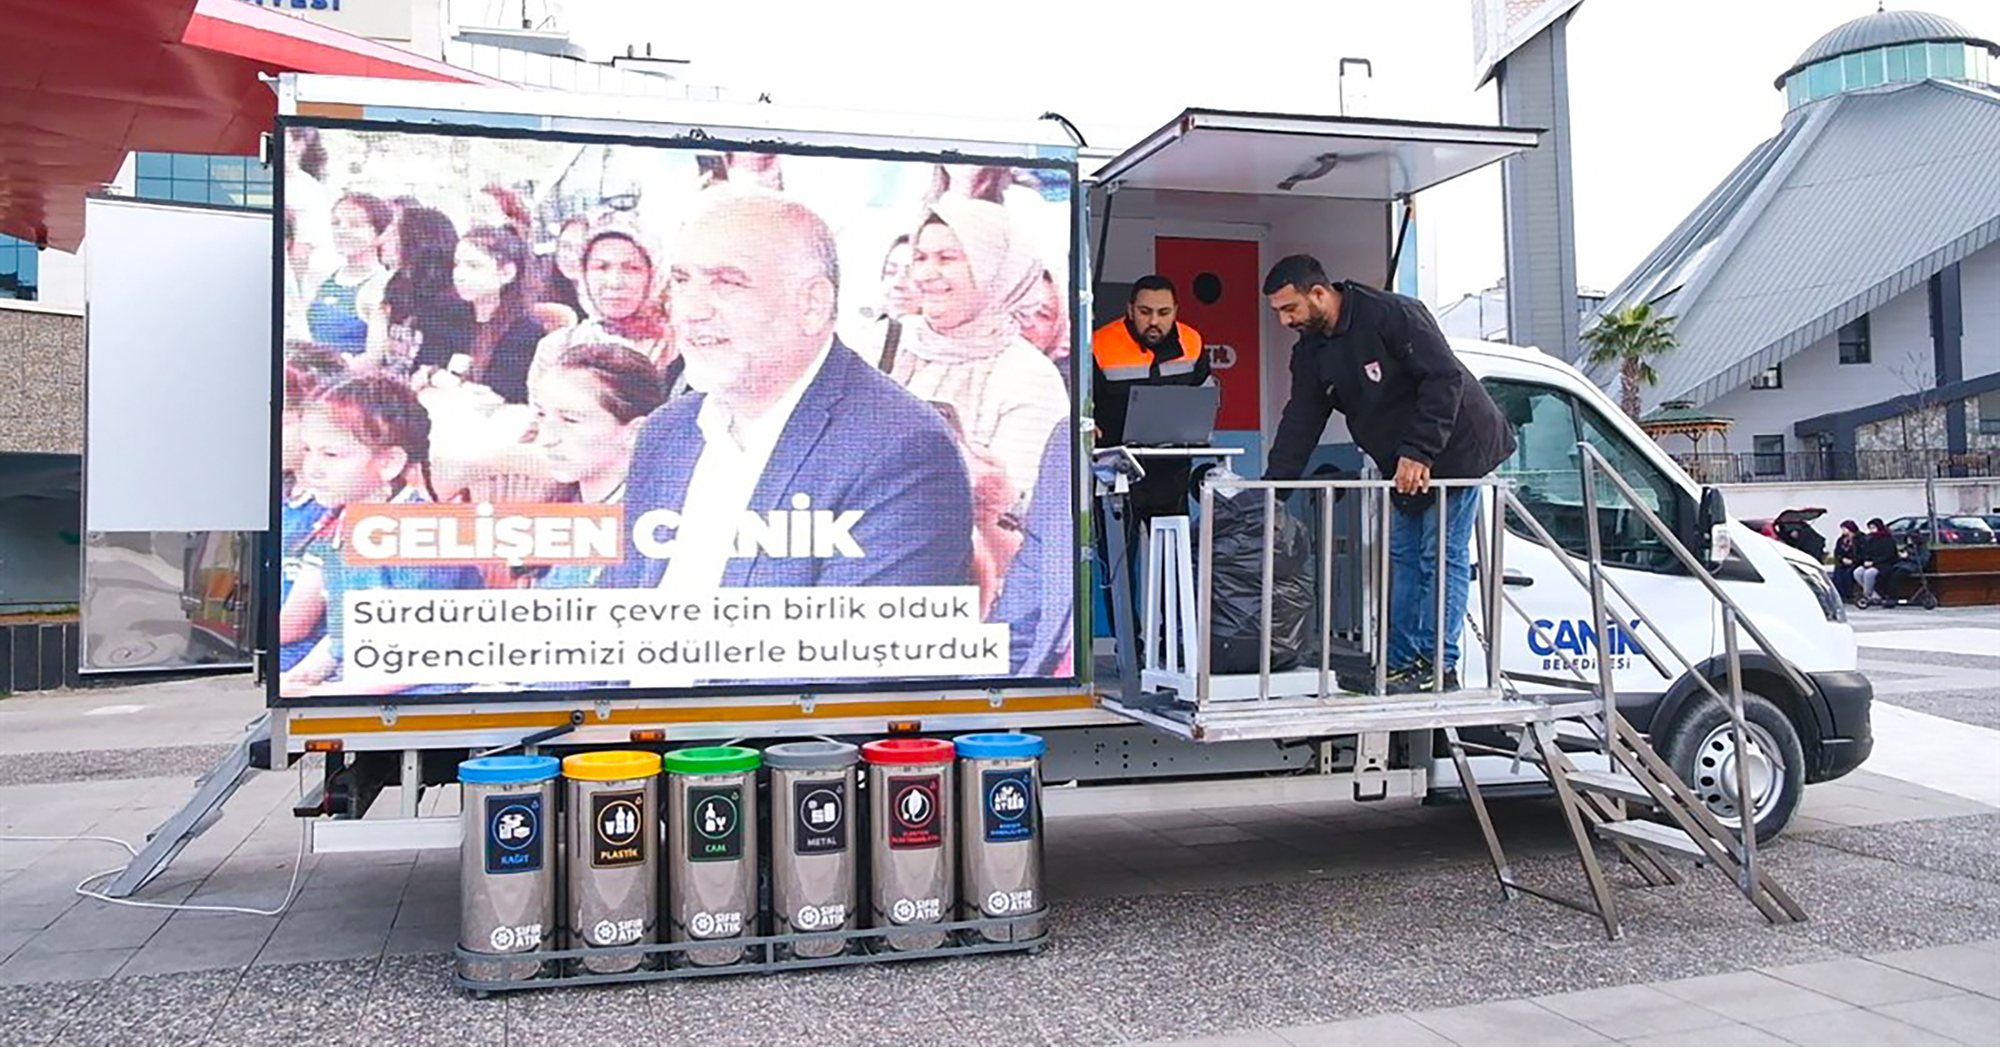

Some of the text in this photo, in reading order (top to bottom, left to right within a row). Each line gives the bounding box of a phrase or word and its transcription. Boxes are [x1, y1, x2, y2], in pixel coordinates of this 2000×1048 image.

[352, 493, 866, 566] GELİŞEN CNİK
[354, 596, 969, 628] Sürdürülebilir çevre için birlik olduk
[354, 638, 999, 674] Öğrencilerimizi ödüllerle buluşturduk
[807, 836, 837, 846] METAL
[600, 848, 640, 859] PLASTİK
[1010, 899, 1032, 911] ATIK
[820, 914, 844, 927] ATIK
[916, 908, 939, 920] ATIK
[715, 922, 741, 935] ATIK
[515, 935, 541, 948] ATIK
[618, 930, 643, 942] ATIK
